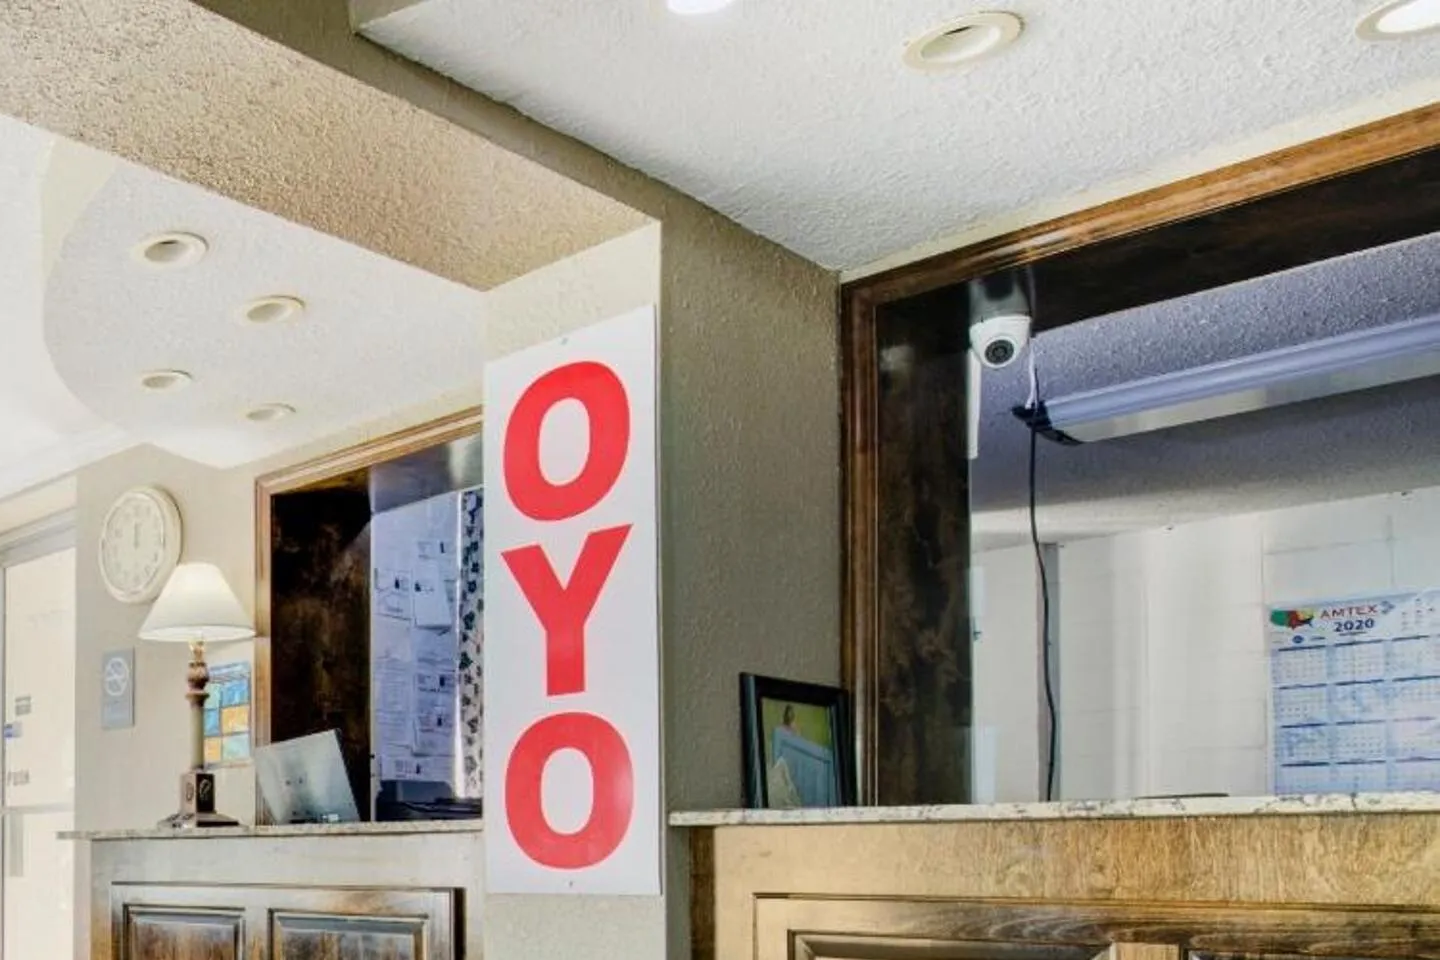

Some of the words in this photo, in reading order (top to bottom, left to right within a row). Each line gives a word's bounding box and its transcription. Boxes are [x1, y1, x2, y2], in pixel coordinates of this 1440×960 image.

[500, 360, 633, 869] OYO
[1320, 604, 1378, 620] AMTEX
[1333, 618, 1375, 633] 2020
